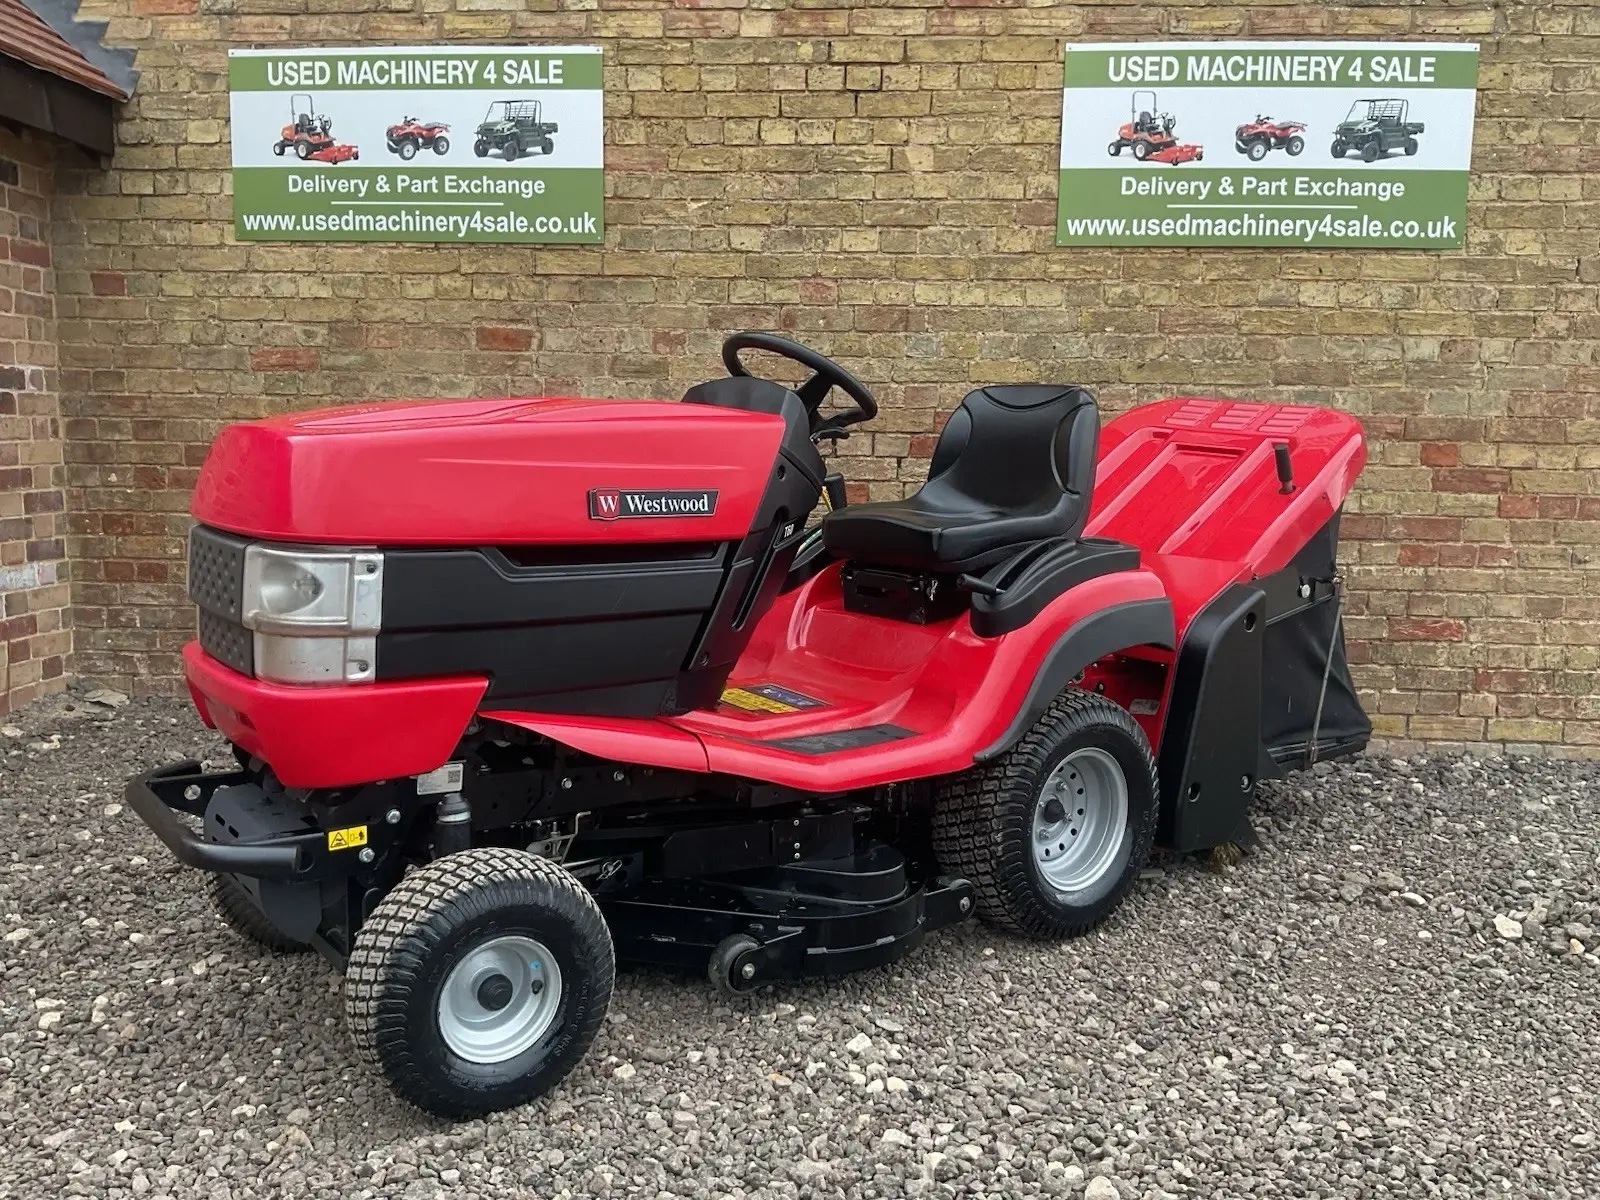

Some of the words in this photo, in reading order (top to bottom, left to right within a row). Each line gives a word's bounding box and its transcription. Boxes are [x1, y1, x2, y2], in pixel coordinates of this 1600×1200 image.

[267, 60, 331, 86] USED
[337, 59, 479, 85] MACHINERY
[483, 60, 498, 84] 4
[502, 59, 564, 85] SALE
[1108, 55, 1180, 83] USED
[1186, 55, 1344, 82] MACHINERY
[1348, 56, 1364, 82] 4
[1369, 55, 1437, 83] SALE
[288, 174, 370, 198] Delivery
[375, 174, 391, 193] &
[396, 174, 439, 194] Part
[444, 174, 546, 199] Exchange
[1120, 176, 1212, 200] Delivery
[1218, 176, 1235, 196] &
[1241, 175, 1288, 196] Part
[1294, 176, 1405, 202] Exchange
[242, 211, 597, 237] www.usedmachinery4sale.co.uk
[1066, 213, 1457, 242] www.usedmachinery4sale.co.uk
[599, 495, 619, 513] W
[625, 493, 710, 513] Westwood
